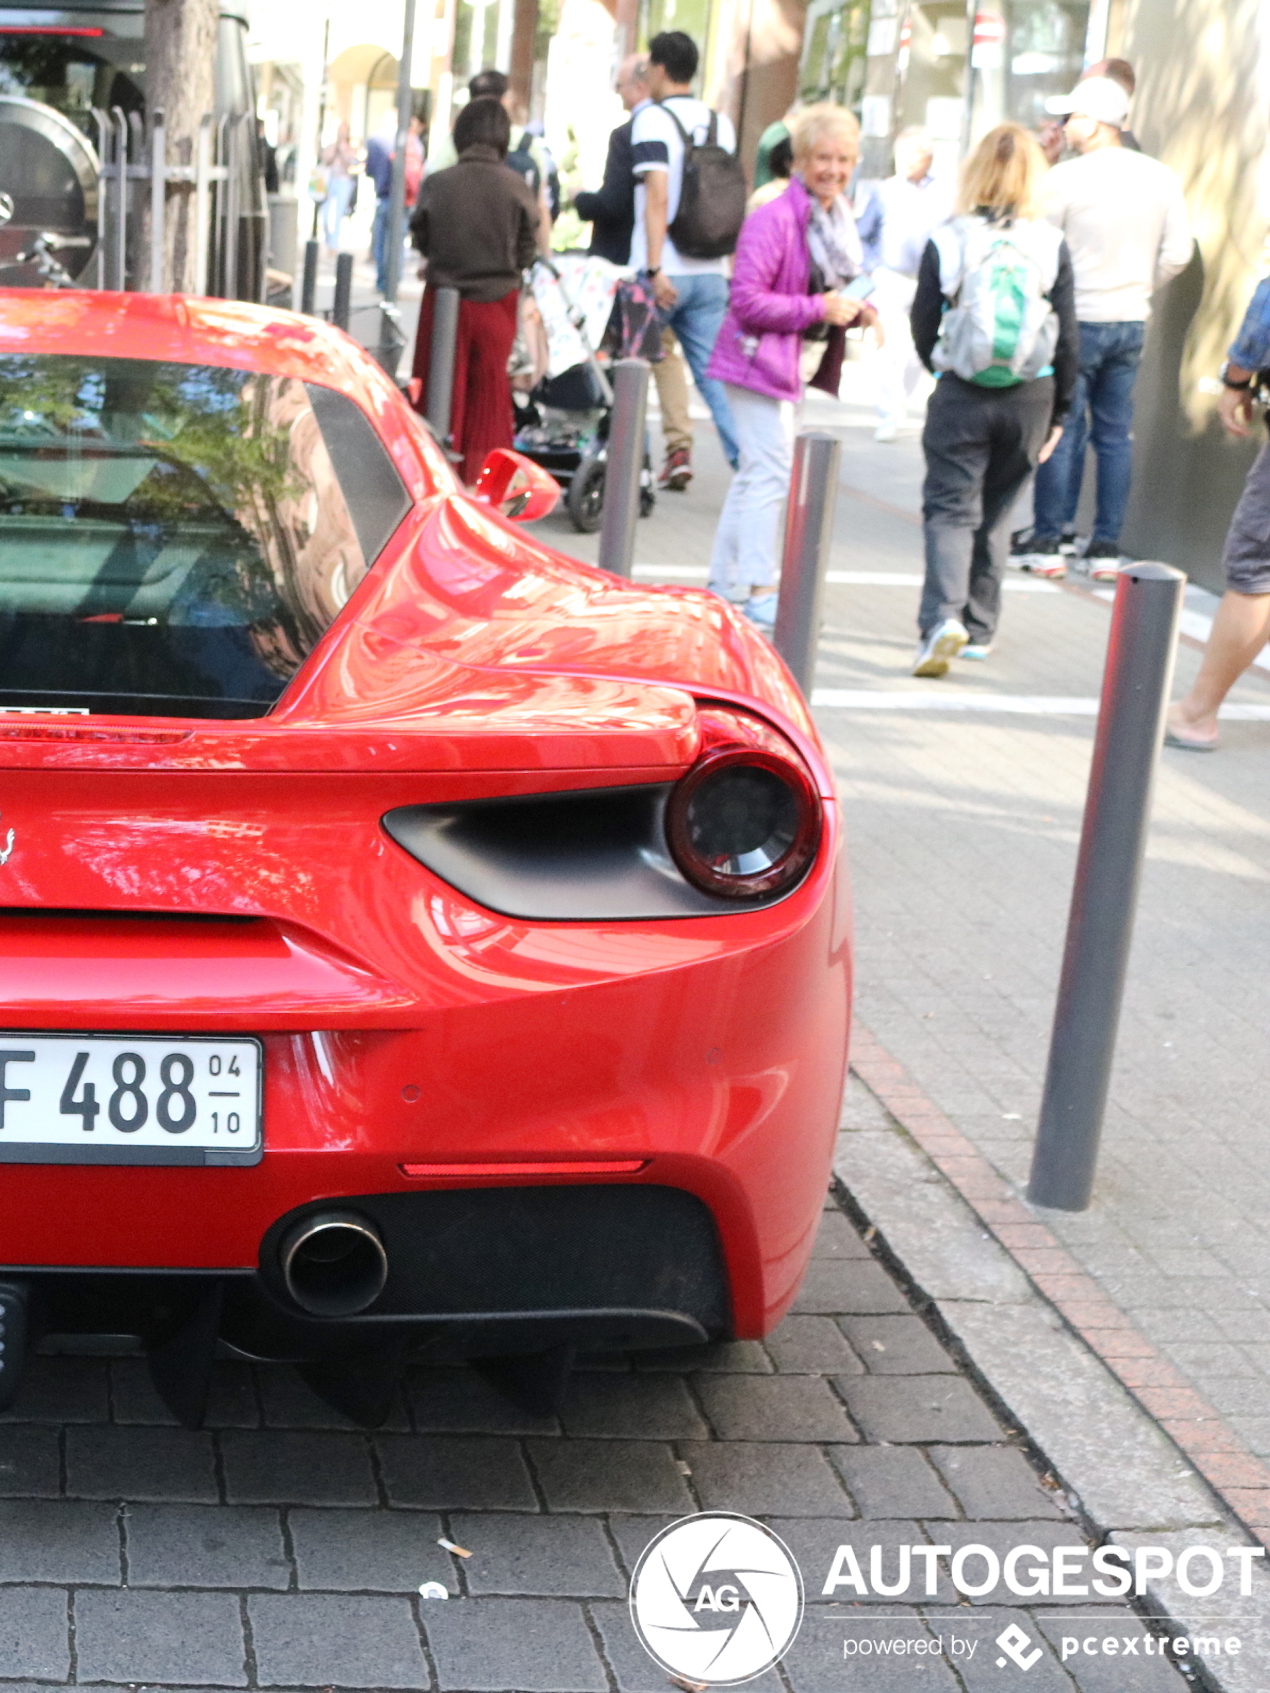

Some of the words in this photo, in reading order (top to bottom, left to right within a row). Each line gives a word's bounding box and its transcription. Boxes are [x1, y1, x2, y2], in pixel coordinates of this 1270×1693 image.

[208, 1055, 241, 1077] 04
[59, 1052, 197, 1134] 488
[211, 1111, 241, 1134] 10
